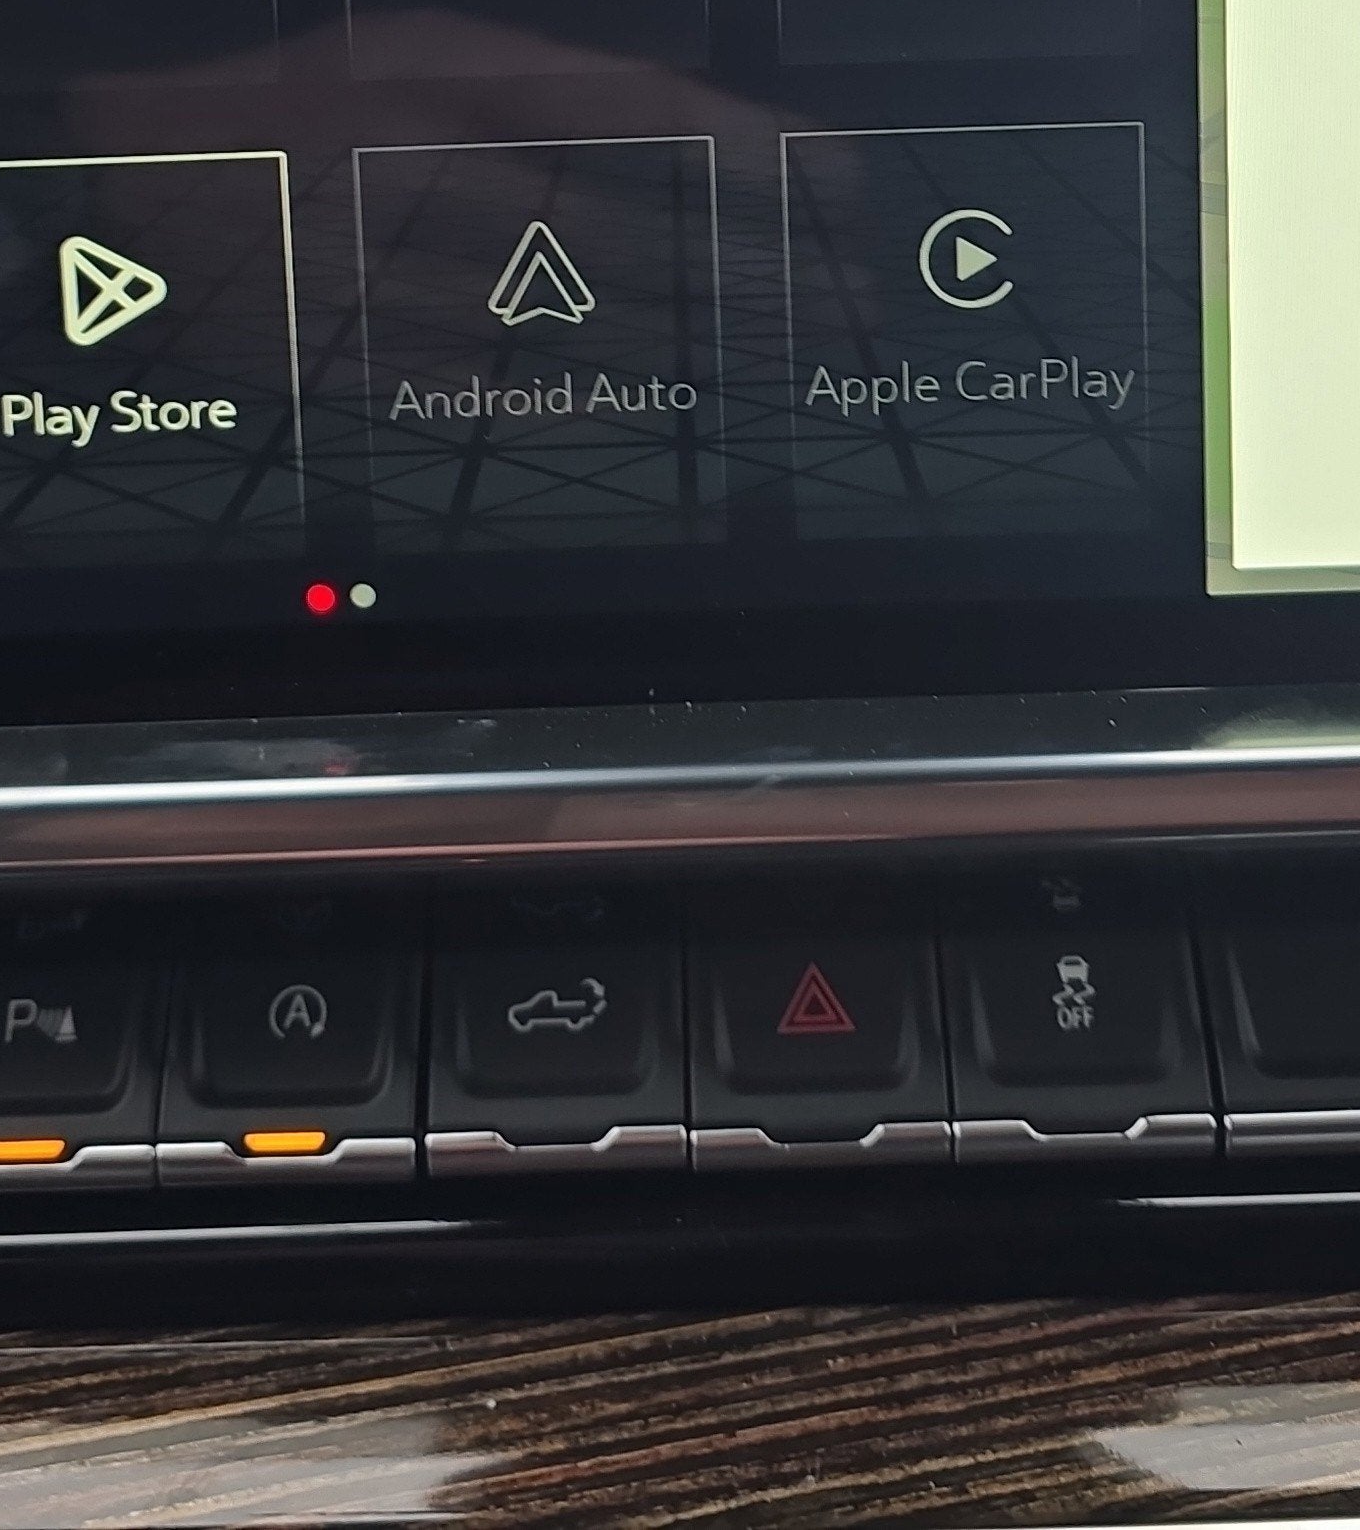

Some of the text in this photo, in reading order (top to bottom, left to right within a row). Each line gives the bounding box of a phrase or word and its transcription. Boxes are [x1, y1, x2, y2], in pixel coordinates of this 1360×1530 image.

[389, 371, 697, 421] Android Auto
[805, 355, 1135, 417] Apple CarPlay
[1, 390, 238, 448] Play Store
[4, 997, 39, 1043] P
[1057, 1004, 1094, 1030] OFF
